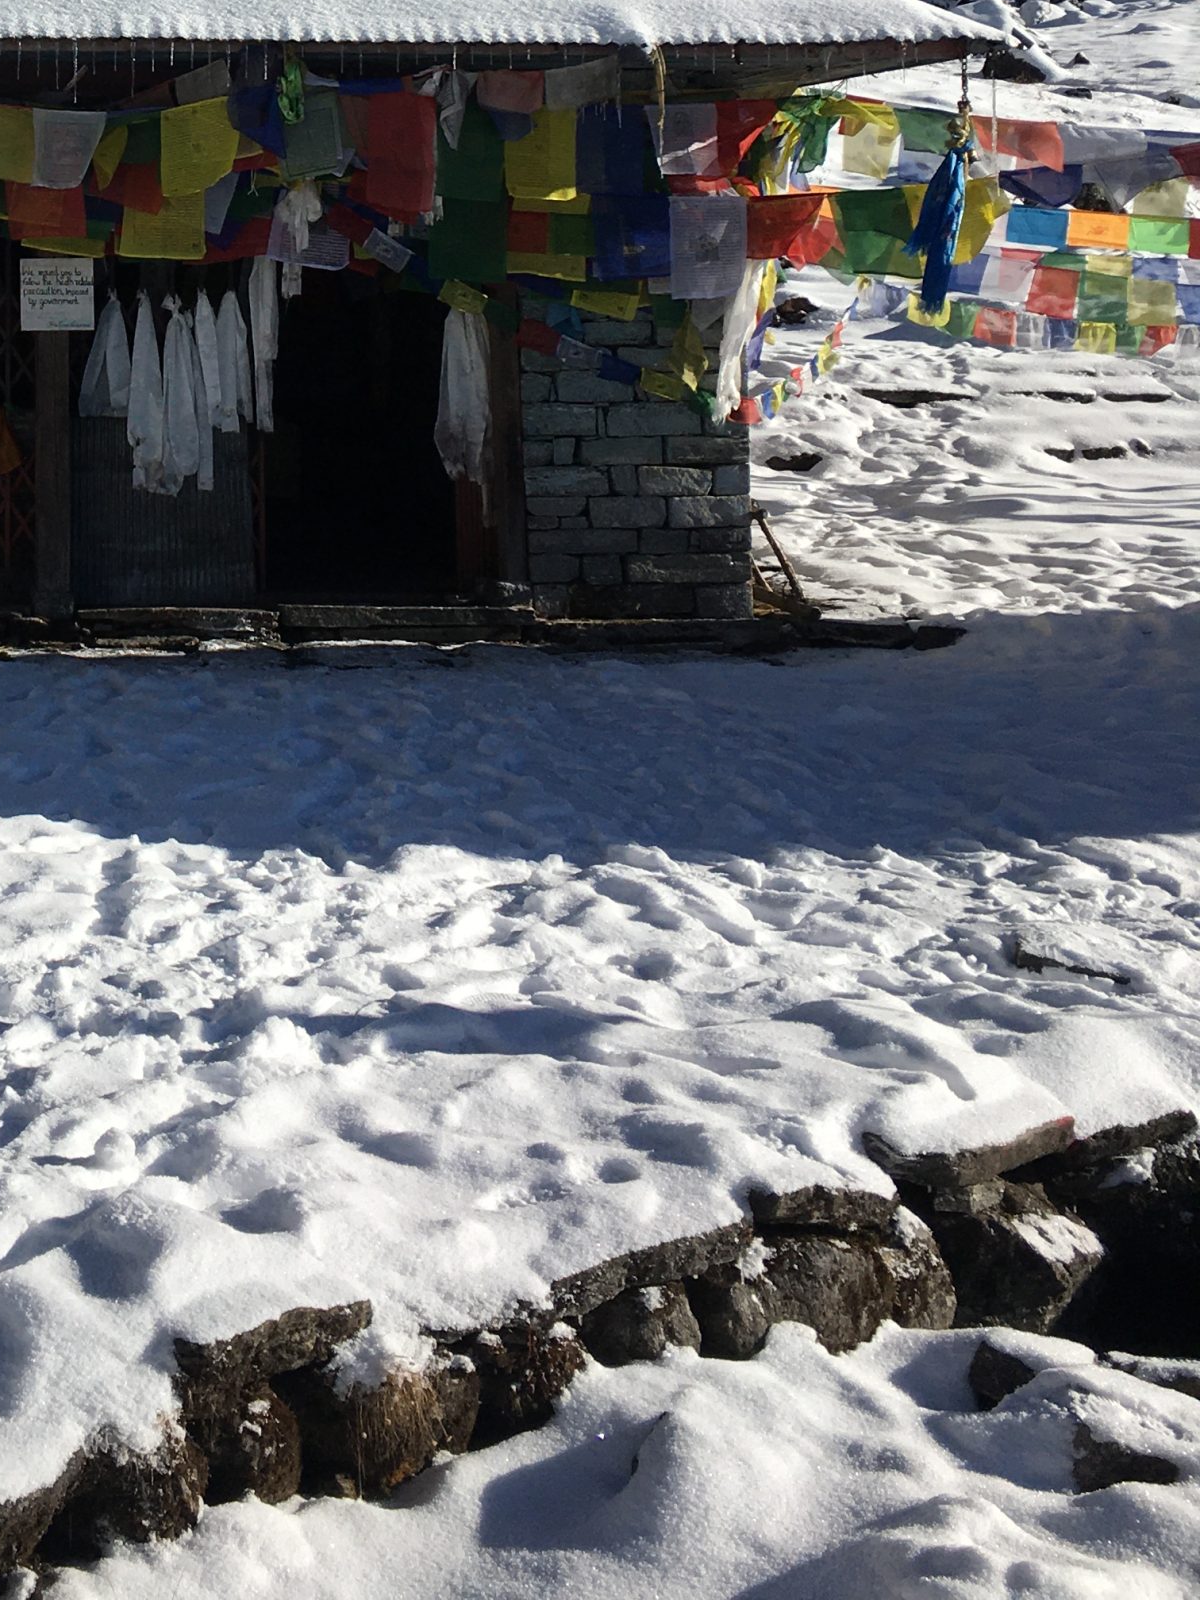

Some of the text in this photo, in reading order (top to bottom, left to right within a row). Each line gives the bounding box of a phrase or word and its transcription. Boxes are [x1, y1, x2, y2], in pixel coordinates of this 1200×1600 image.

[60, 270, 73, 279] you
[74, 267, 82, 276] to
[28, 297, 37, 309] by
